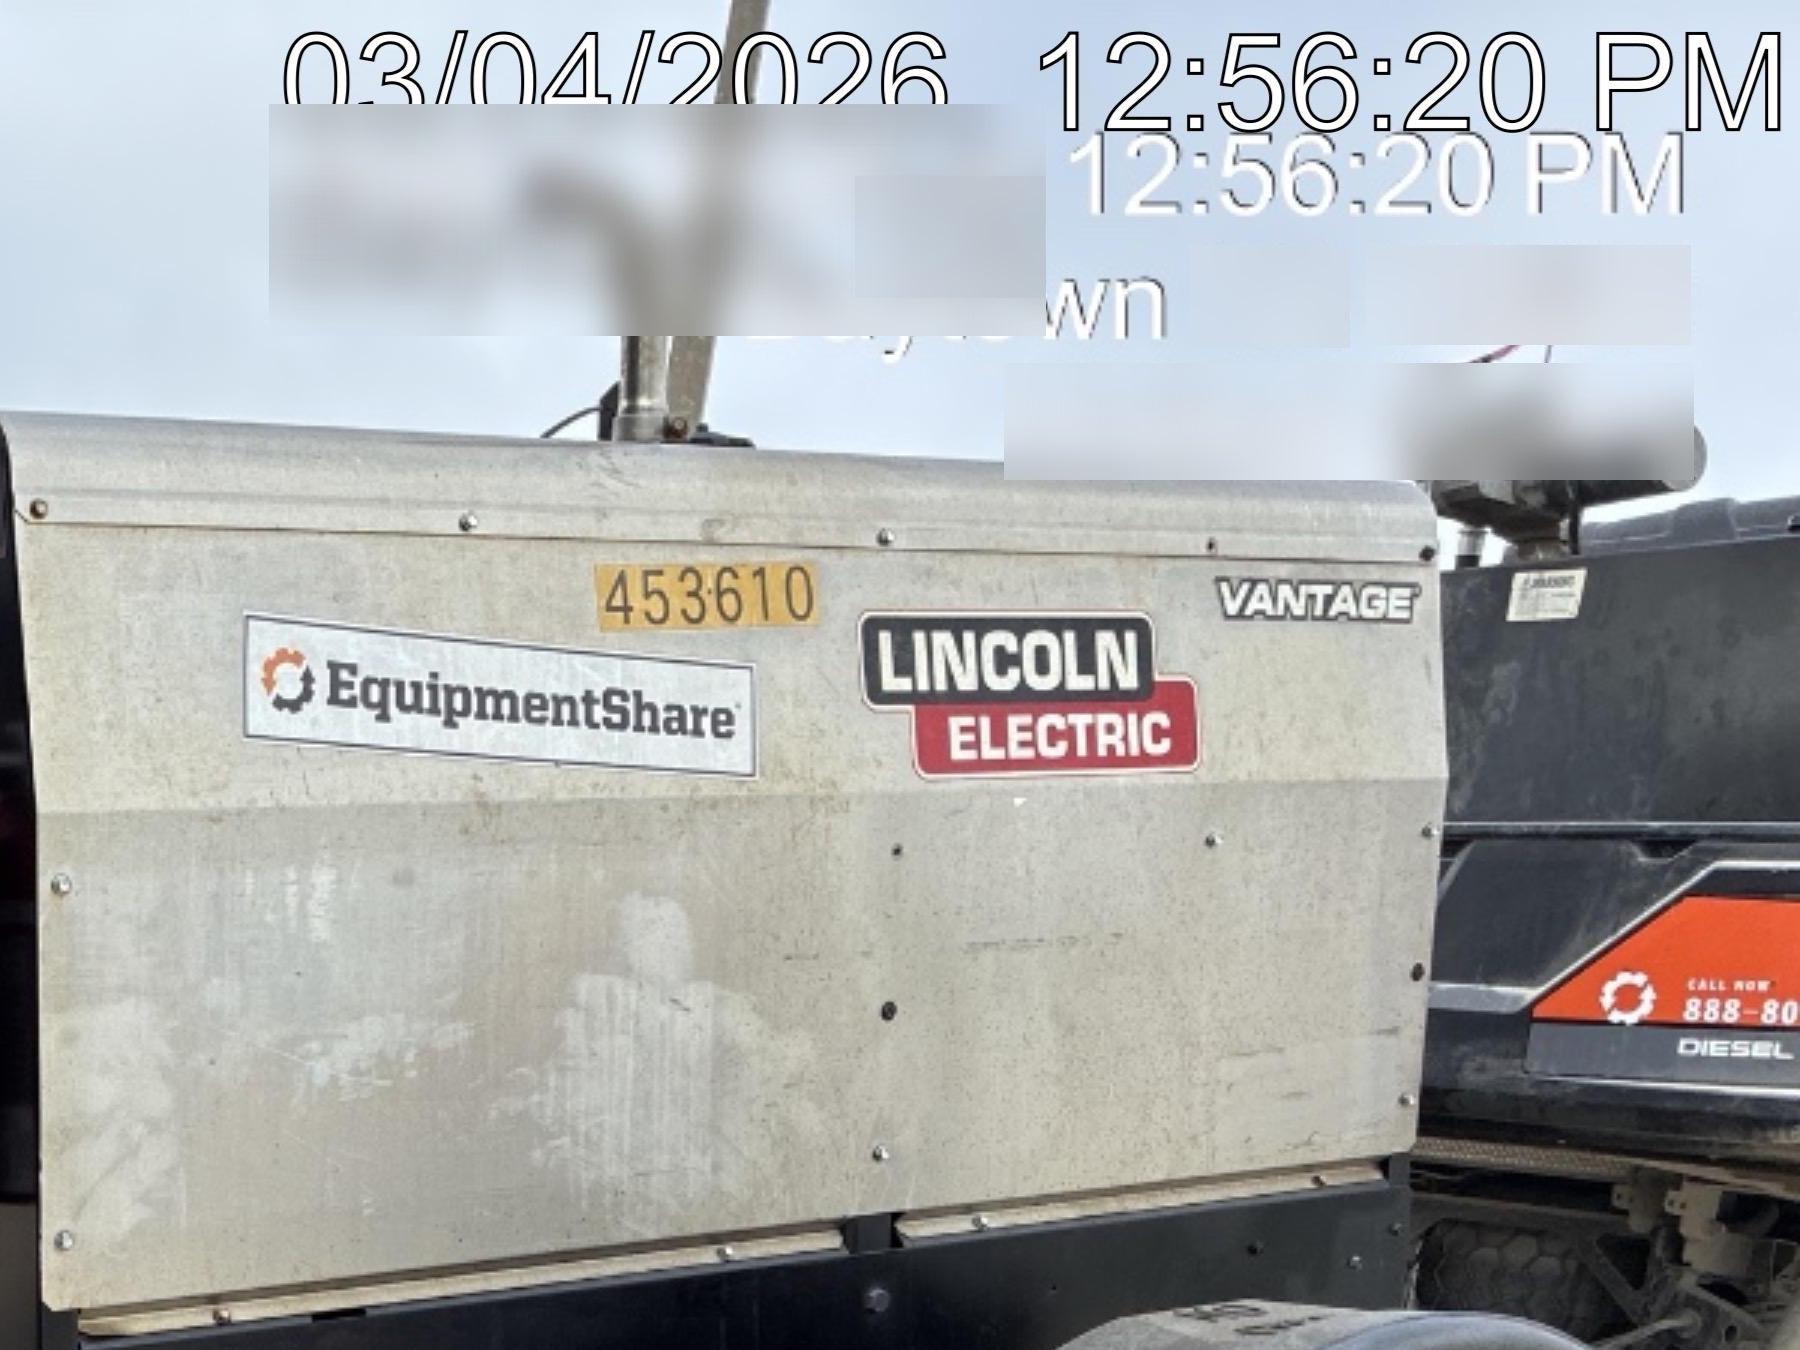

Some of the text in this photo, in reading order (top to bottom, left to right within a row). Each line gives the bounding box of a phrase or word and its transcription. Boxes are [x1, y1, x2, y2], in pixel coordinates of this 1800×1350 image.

[604, 566, 814, 625] 453610
[1215, 577, 1416, 623] VANTAGE
[878, 630, 1139, 693] LINCOLN
[326, 660, 736, 739] EquipmentShare
[947, 711, 1171, 761] ELECTRIC
[1687, 978, 1726, 991] CALL
[1677, 1037, 1794, 1059] DIESEL
